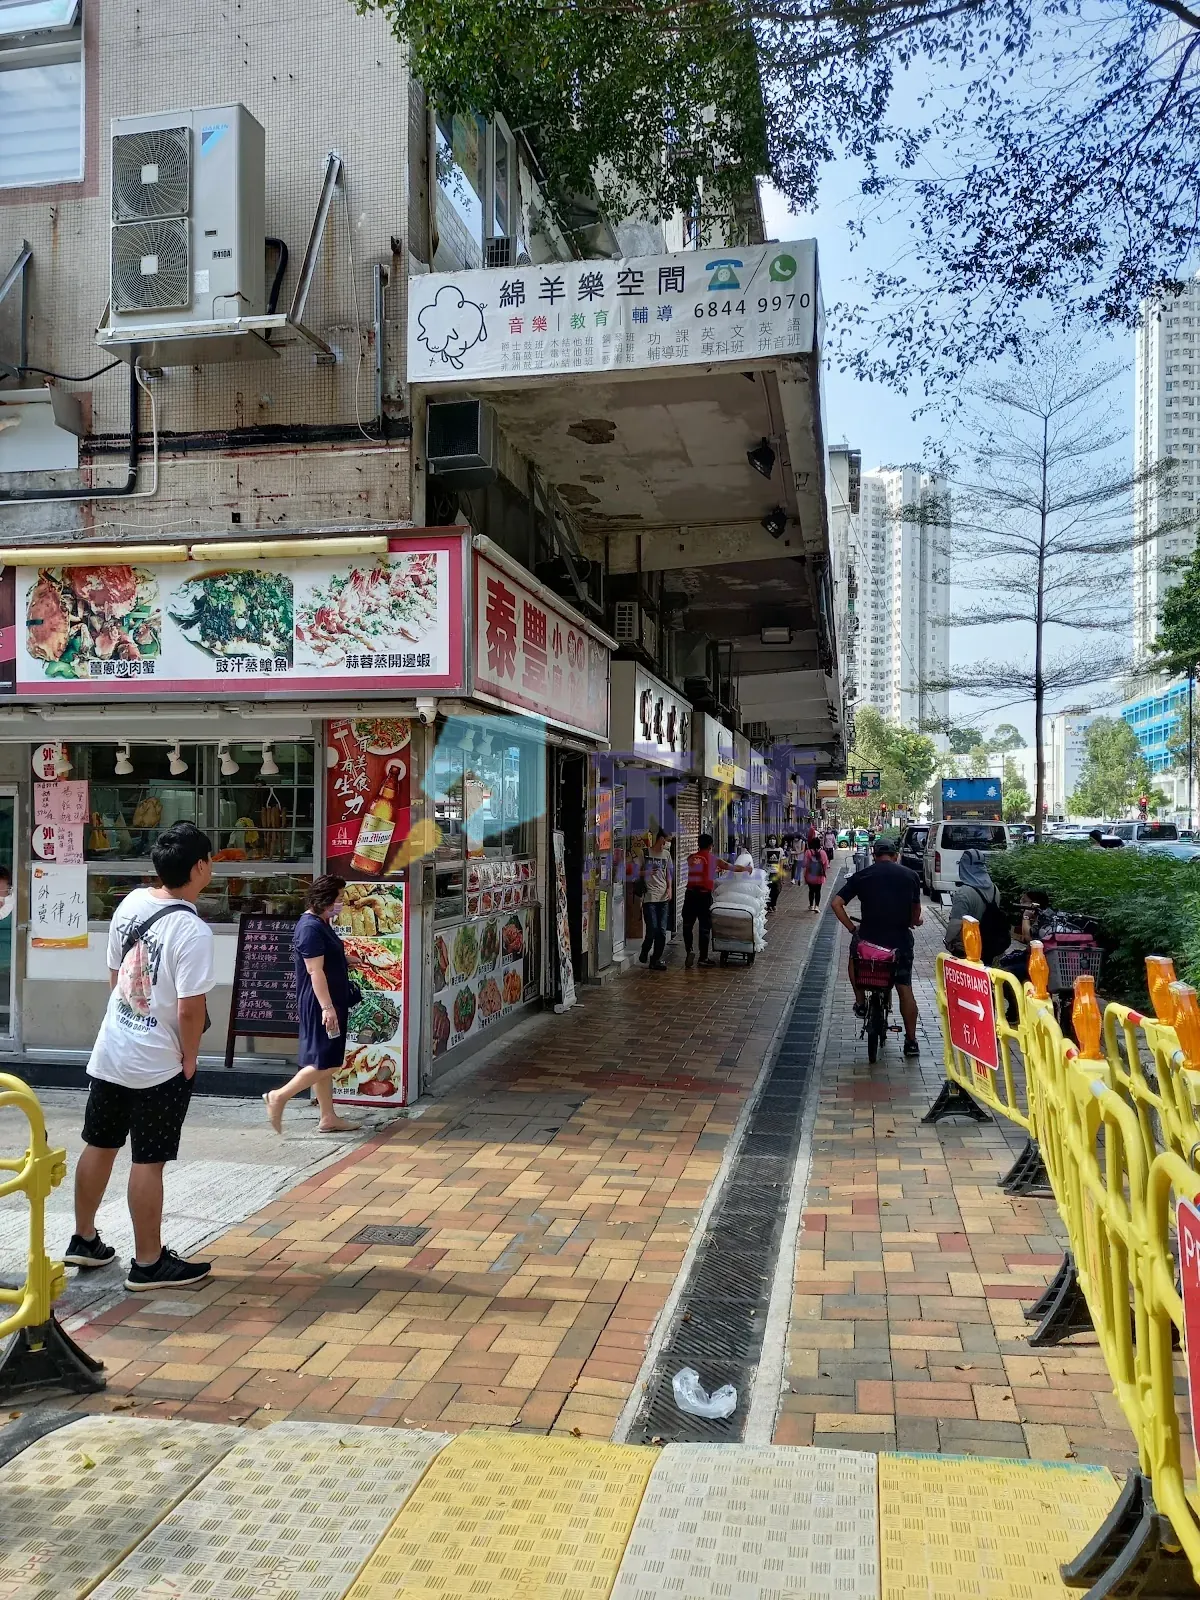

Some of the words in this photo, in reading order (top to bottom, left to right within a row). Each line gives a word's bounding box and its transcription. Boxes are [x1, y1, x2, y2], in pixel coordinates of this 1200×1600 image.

[202, 123, 229, 132] DAIKIN
[499, 265, 686, 309] 綿羊樂空間
[508, 314, 548, 335] 音樂
[570, 309, 609, 330] 教育
[631, 304, 673, 324] 輔導
[694, 299, 746, 318] 6844
[757, 293, 810, 313] 9970
[550, 335, 594, 348] 木結他班
[647, 329, 689, 345] 功課
[701, 324, 744, 341] 英文
[758, 317, 801, 337] 英語
[647, 344, 689, 360] 輔導班
[701, 339, 745, 355] 專科班
[757, 332, 801, 351] 拼音班
[42, 826, 55, 856] 外賣
[945, 965, 989, 997] PEDESTRIANS
[963, 1023, 980, 1050] 行人
